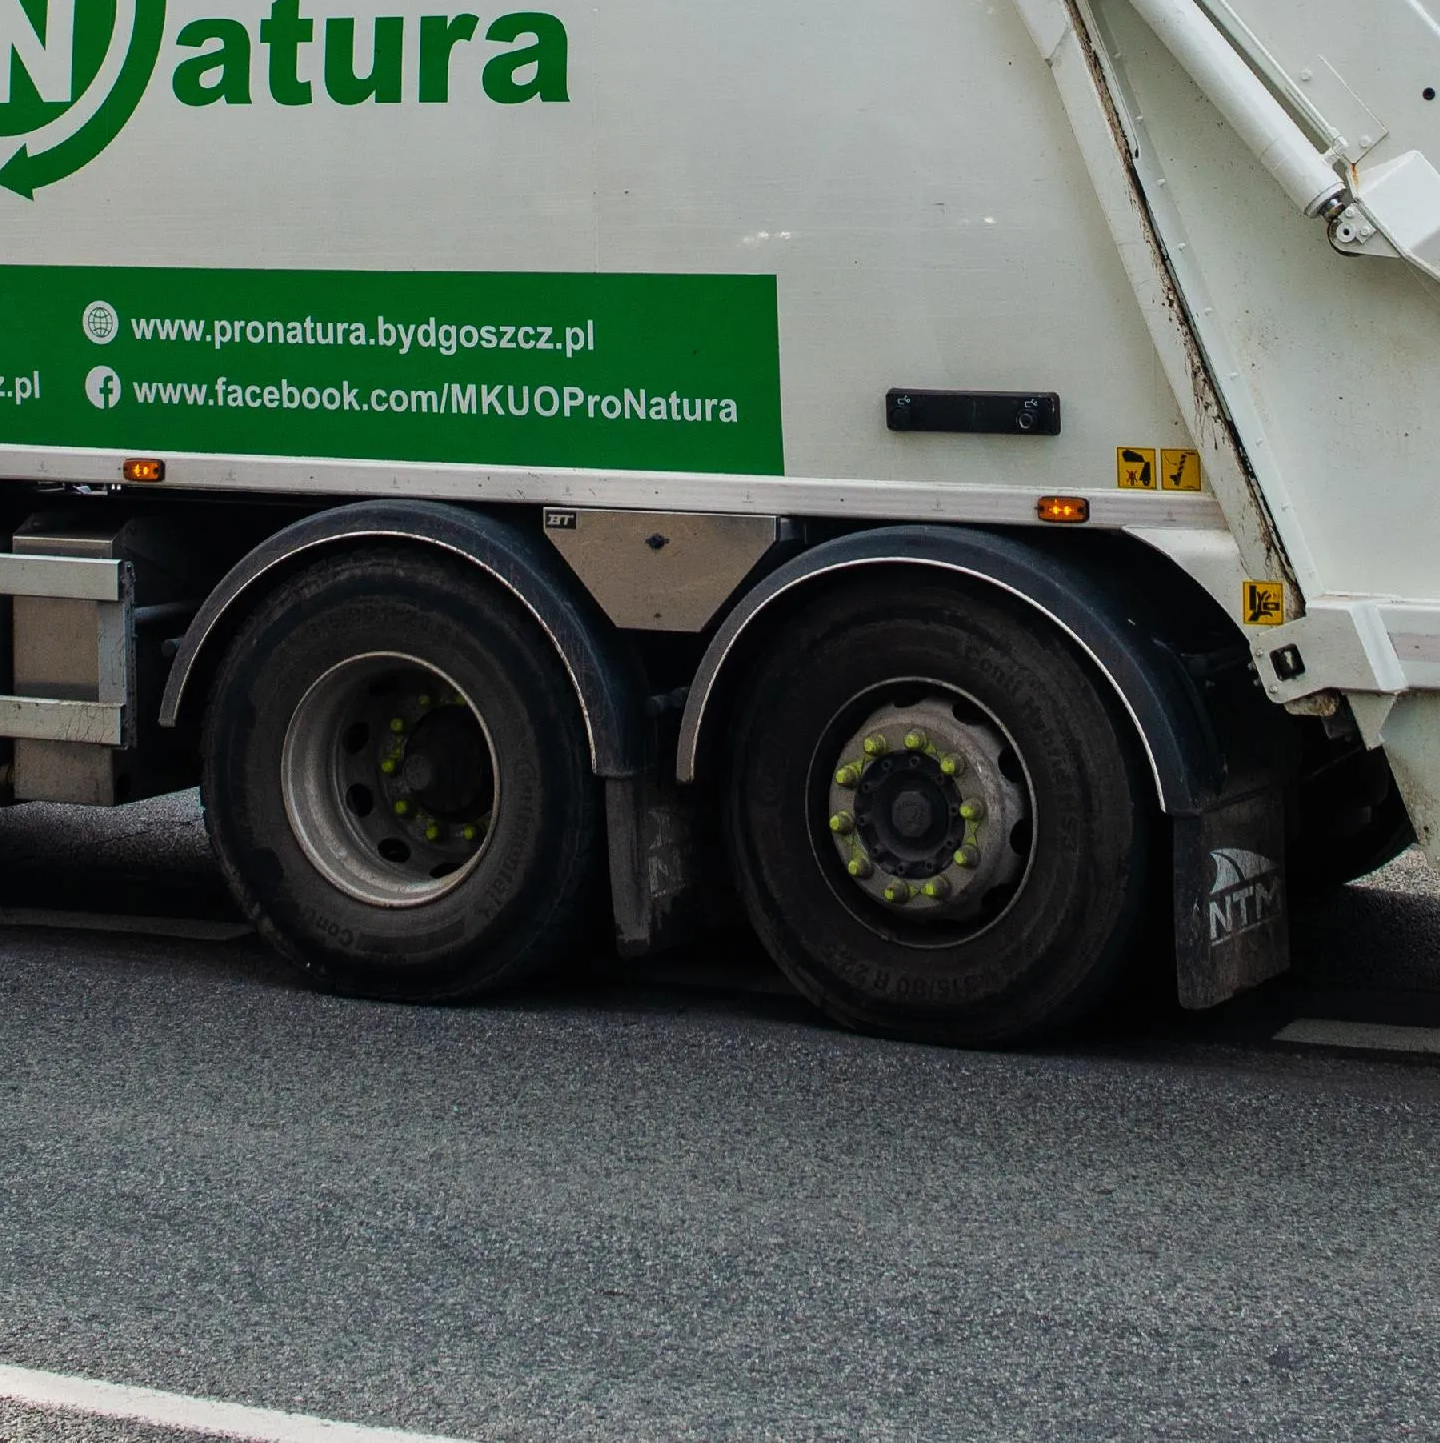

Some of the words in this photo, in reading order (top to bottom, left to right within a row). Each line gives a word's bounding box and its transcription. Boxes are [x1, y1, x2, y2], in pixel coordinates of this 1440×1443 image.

[131, 316, 595, 358] www.pronatura.bydgoszcz.pl
[133, 376, 738, 423] www.facebook.com/MKUOProNatura
[1208, 874, 1281, 940] NTM
